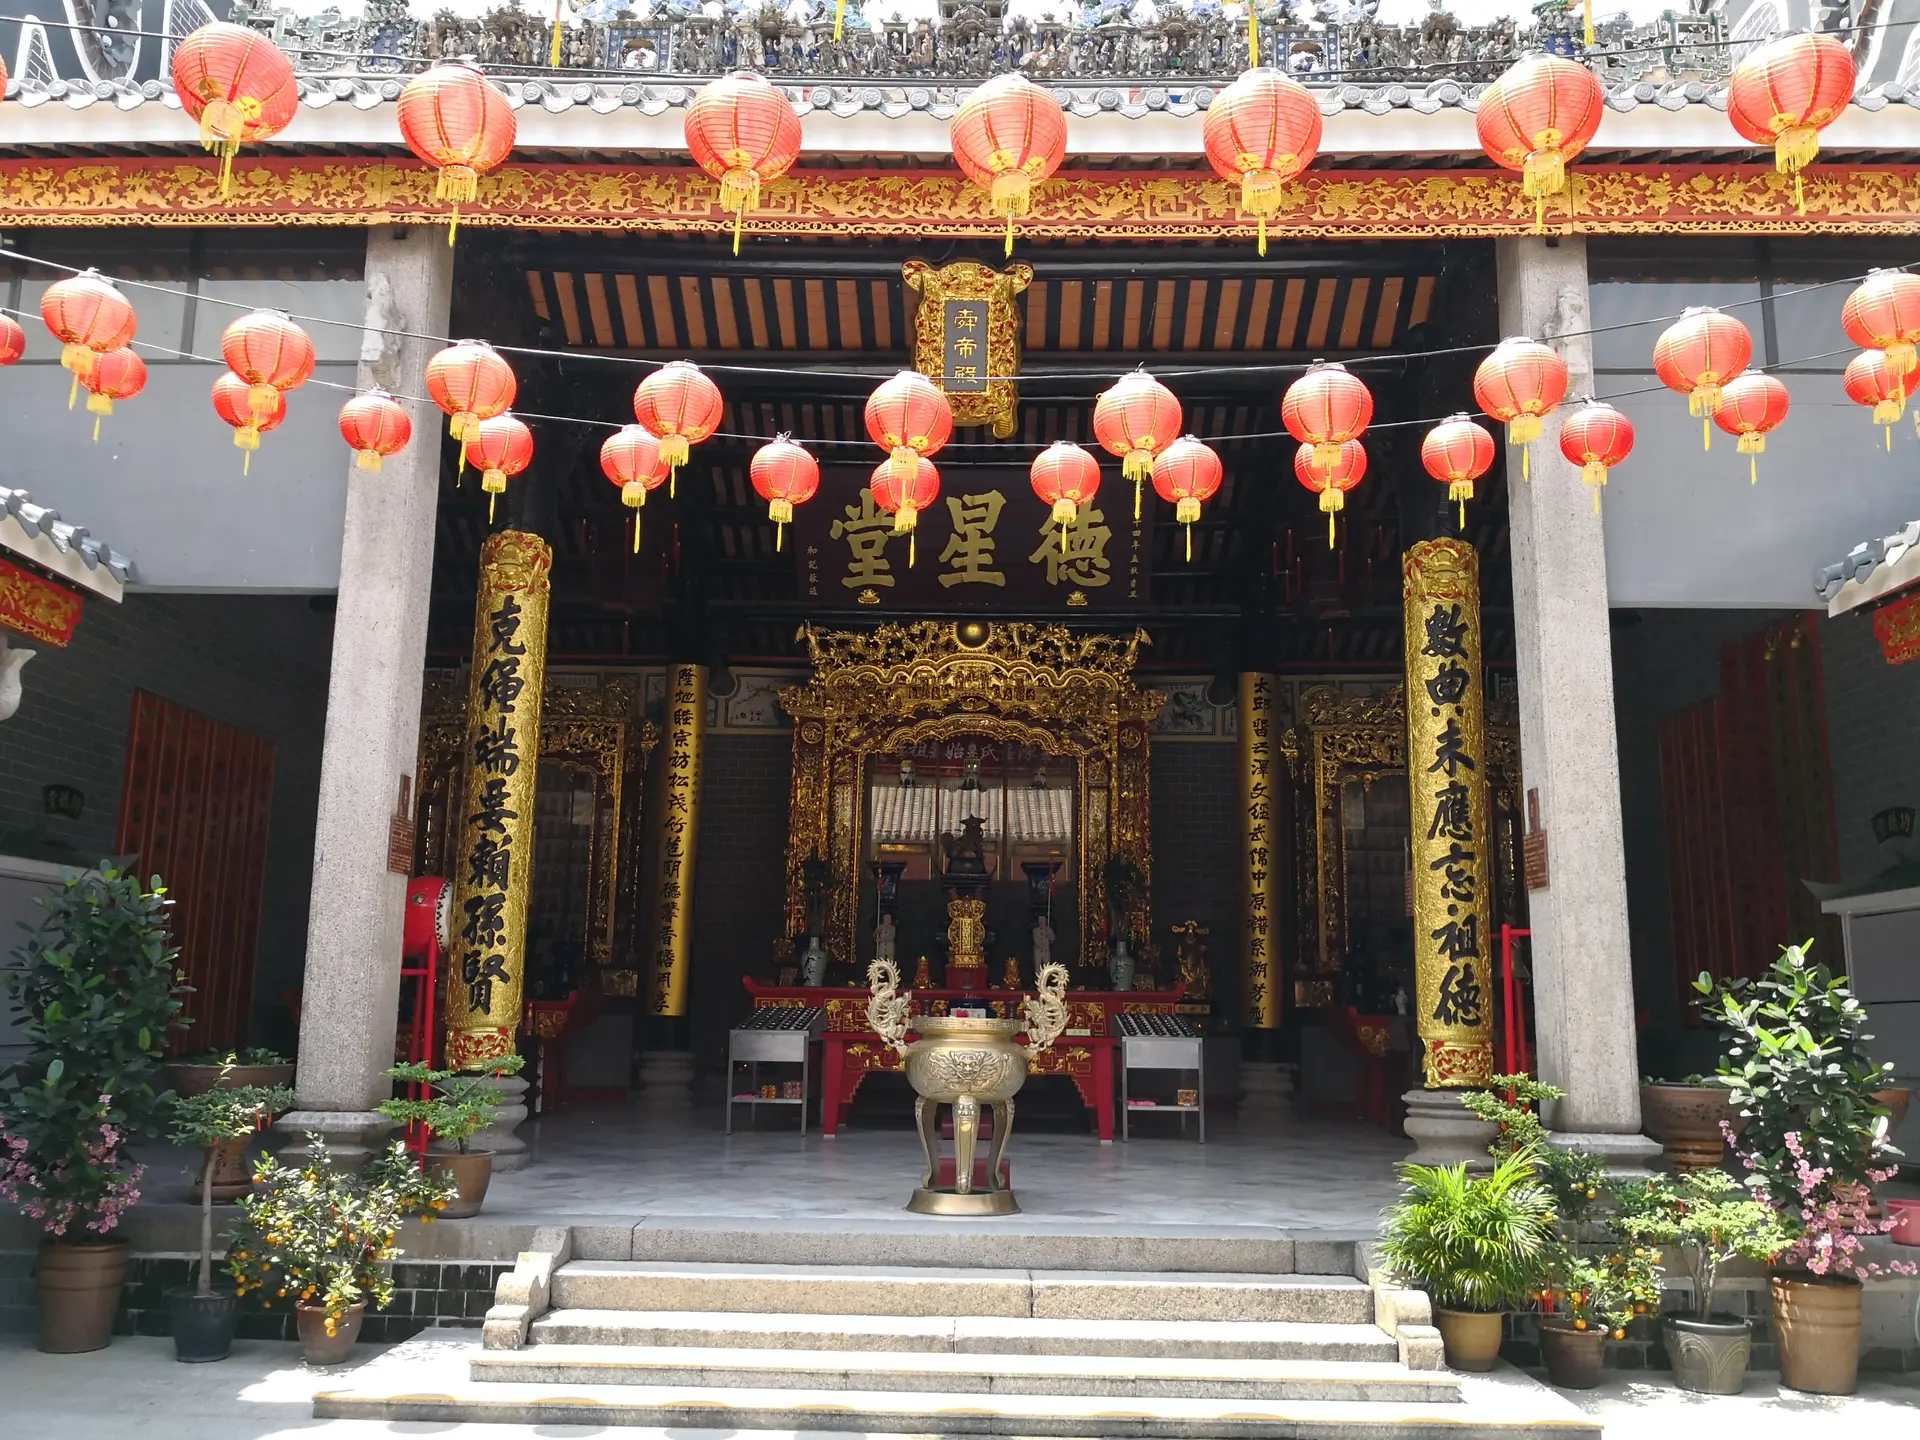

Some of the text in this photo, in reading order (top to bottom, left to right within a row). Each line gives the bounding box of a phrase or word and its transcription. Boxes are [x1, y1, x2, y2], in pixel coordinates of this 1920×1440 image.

[953, 308, 978, 385] 舜帝殿
[829, 488, 1113, 588] 德星堂
[1422, 604, 1482, 1027] 數典未應忘祖德
